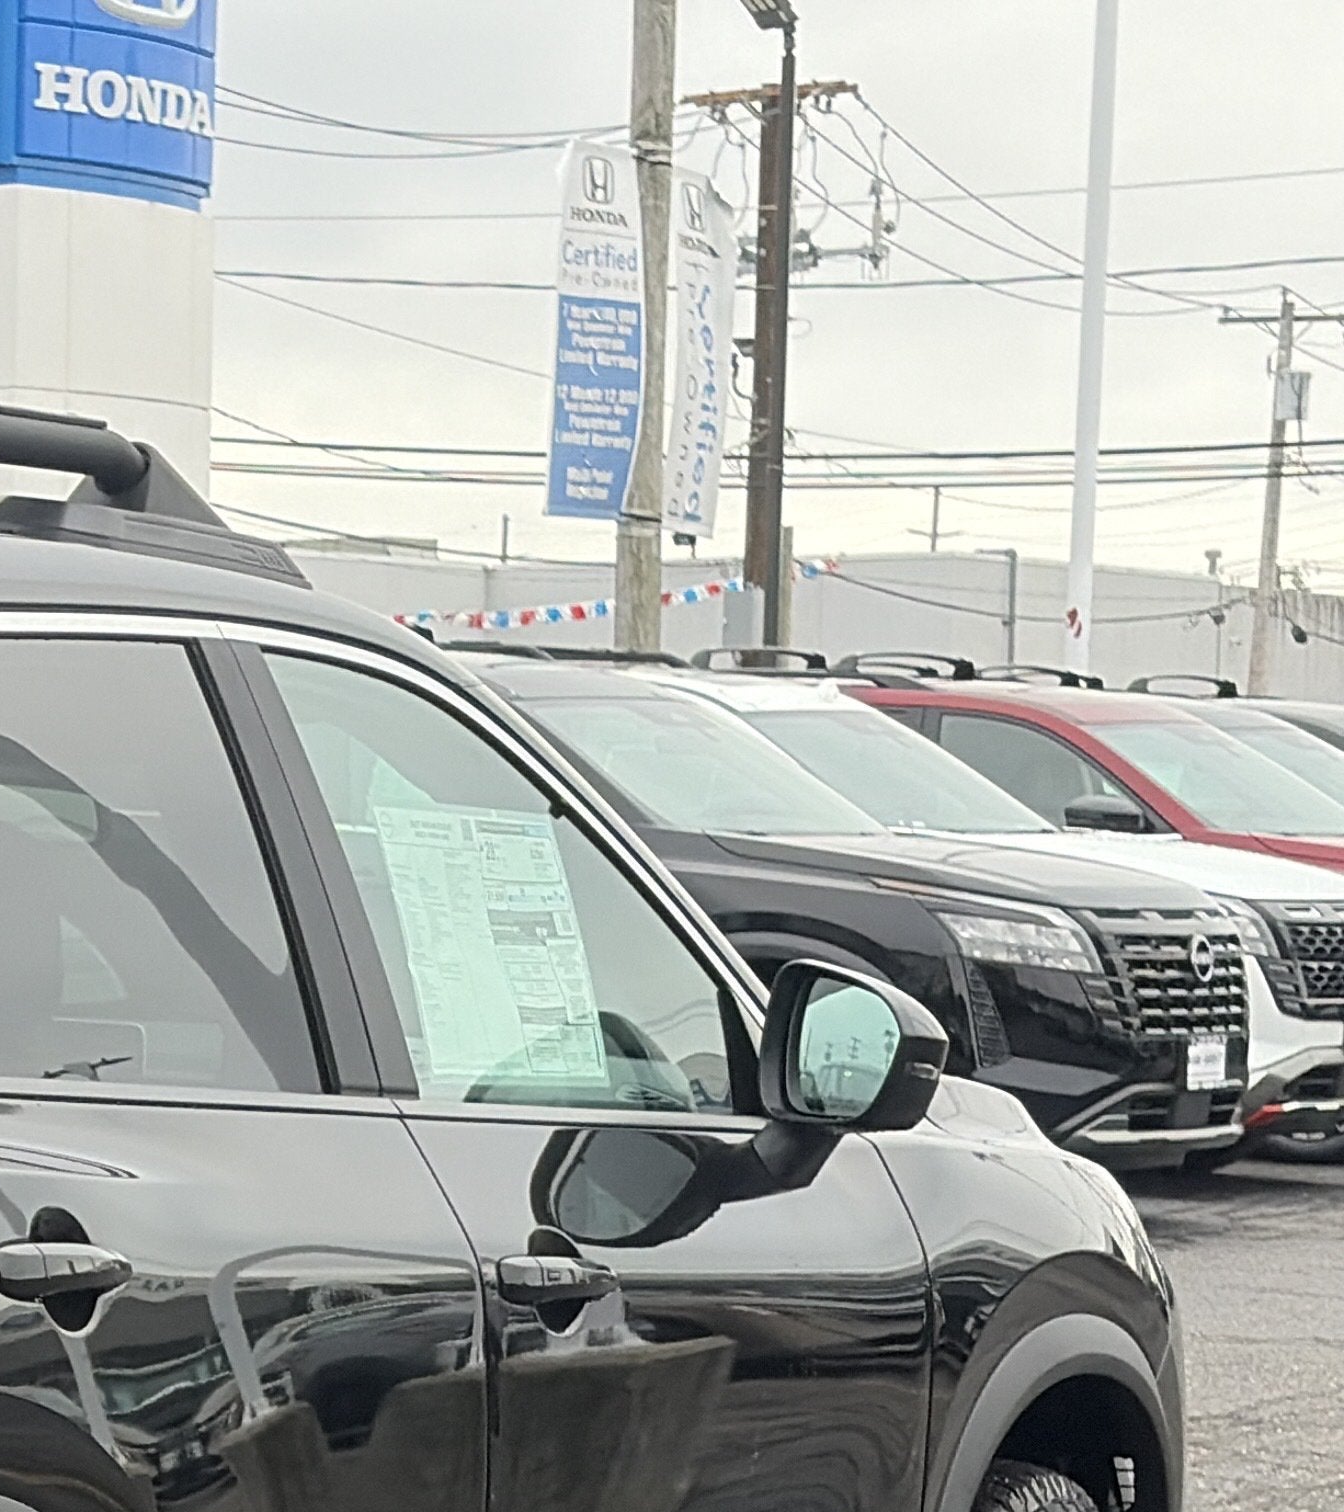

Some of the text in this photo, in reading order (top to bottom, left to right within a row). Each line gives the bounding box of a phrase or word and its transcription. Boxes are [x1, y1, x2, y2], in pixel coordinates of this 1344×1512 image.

[33, 62, 216, 138] HONDA
[570, 206, 628, 228] HONDA
[562, 238, 638, 272] Certified
